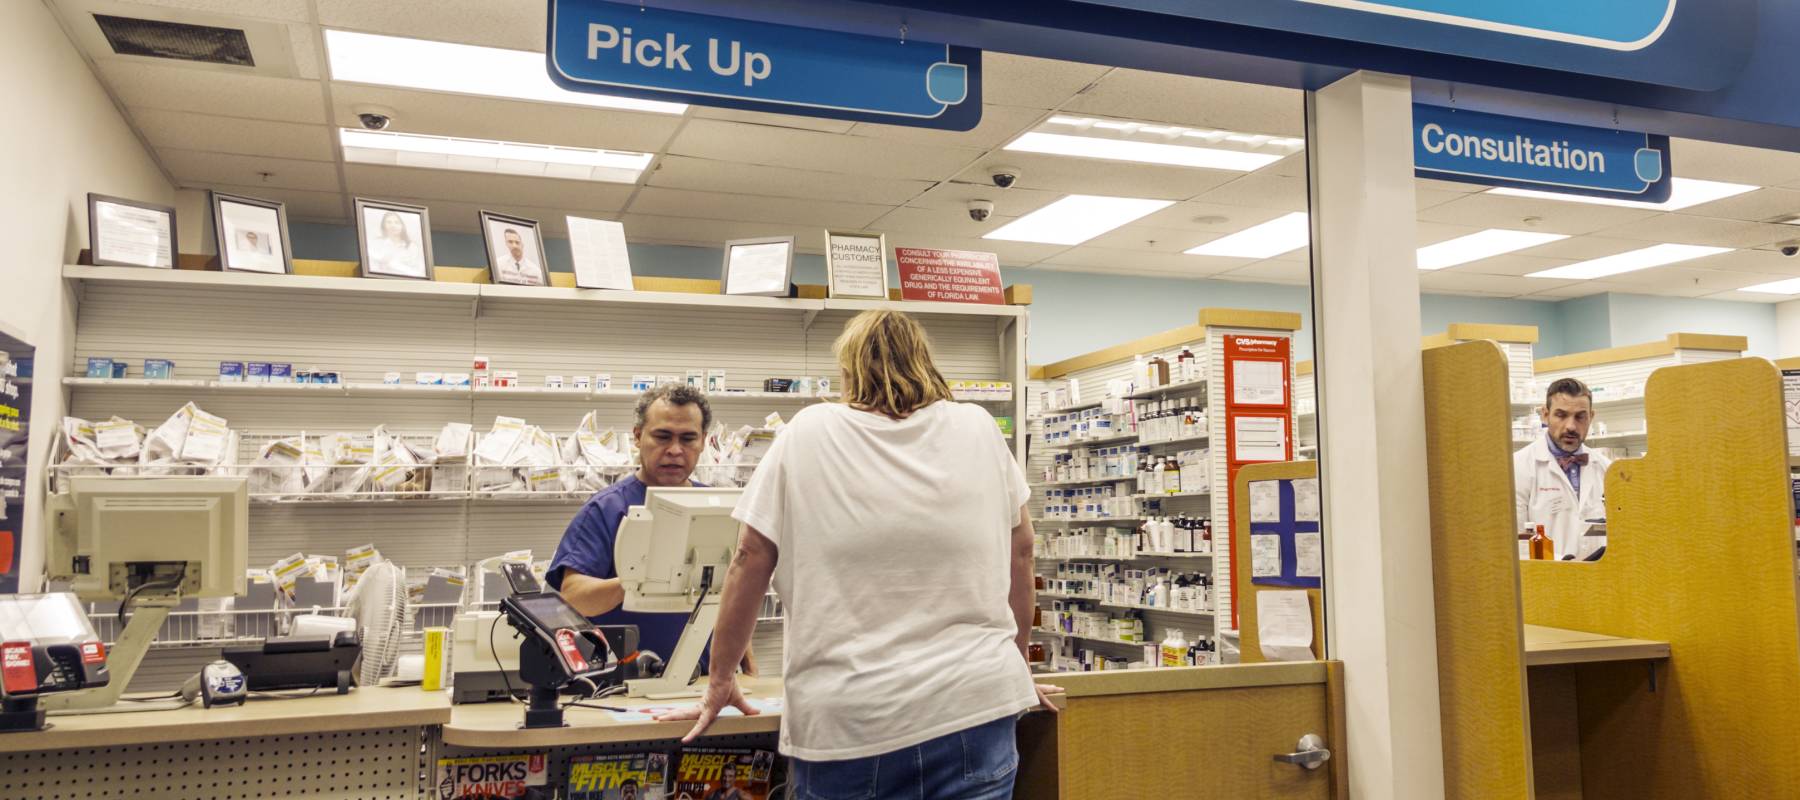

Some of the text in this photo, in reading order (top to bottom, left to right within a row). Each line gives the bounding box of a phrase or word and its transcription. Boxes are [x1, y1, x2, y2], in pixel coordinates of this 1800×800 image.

[587, 22, 772, 87] Pick Up
[1421, 123, 1605, 173] Consultation
[831, 243, 880, 253] PHARMACY
[902, 248, 931, 257] CONSULT
[831, 253, 881, 263] CUSTOMER
[900, 256, 942, 266] CONCERNING
[942, 258, 955, 267] THE
[917, 265, 926, 273] OF
[933, 266, 948, 275] LESS
[949, 267, 982, 277] EXPENSIVE
[910, 273, 990, 285] GENERICALLY EQUIVALENT
[904, 281, 1000, 294] DRUG AND THE REQUIREMENTS
[938, 292, 963, 300] FLORIDA
[680, 753, 737, 767] MUSCLE
[456, 761, 527, 783] FORKS
[571, 761, 631, 775] MUSCLE
[462, 780, 527, 799] KNIVES
